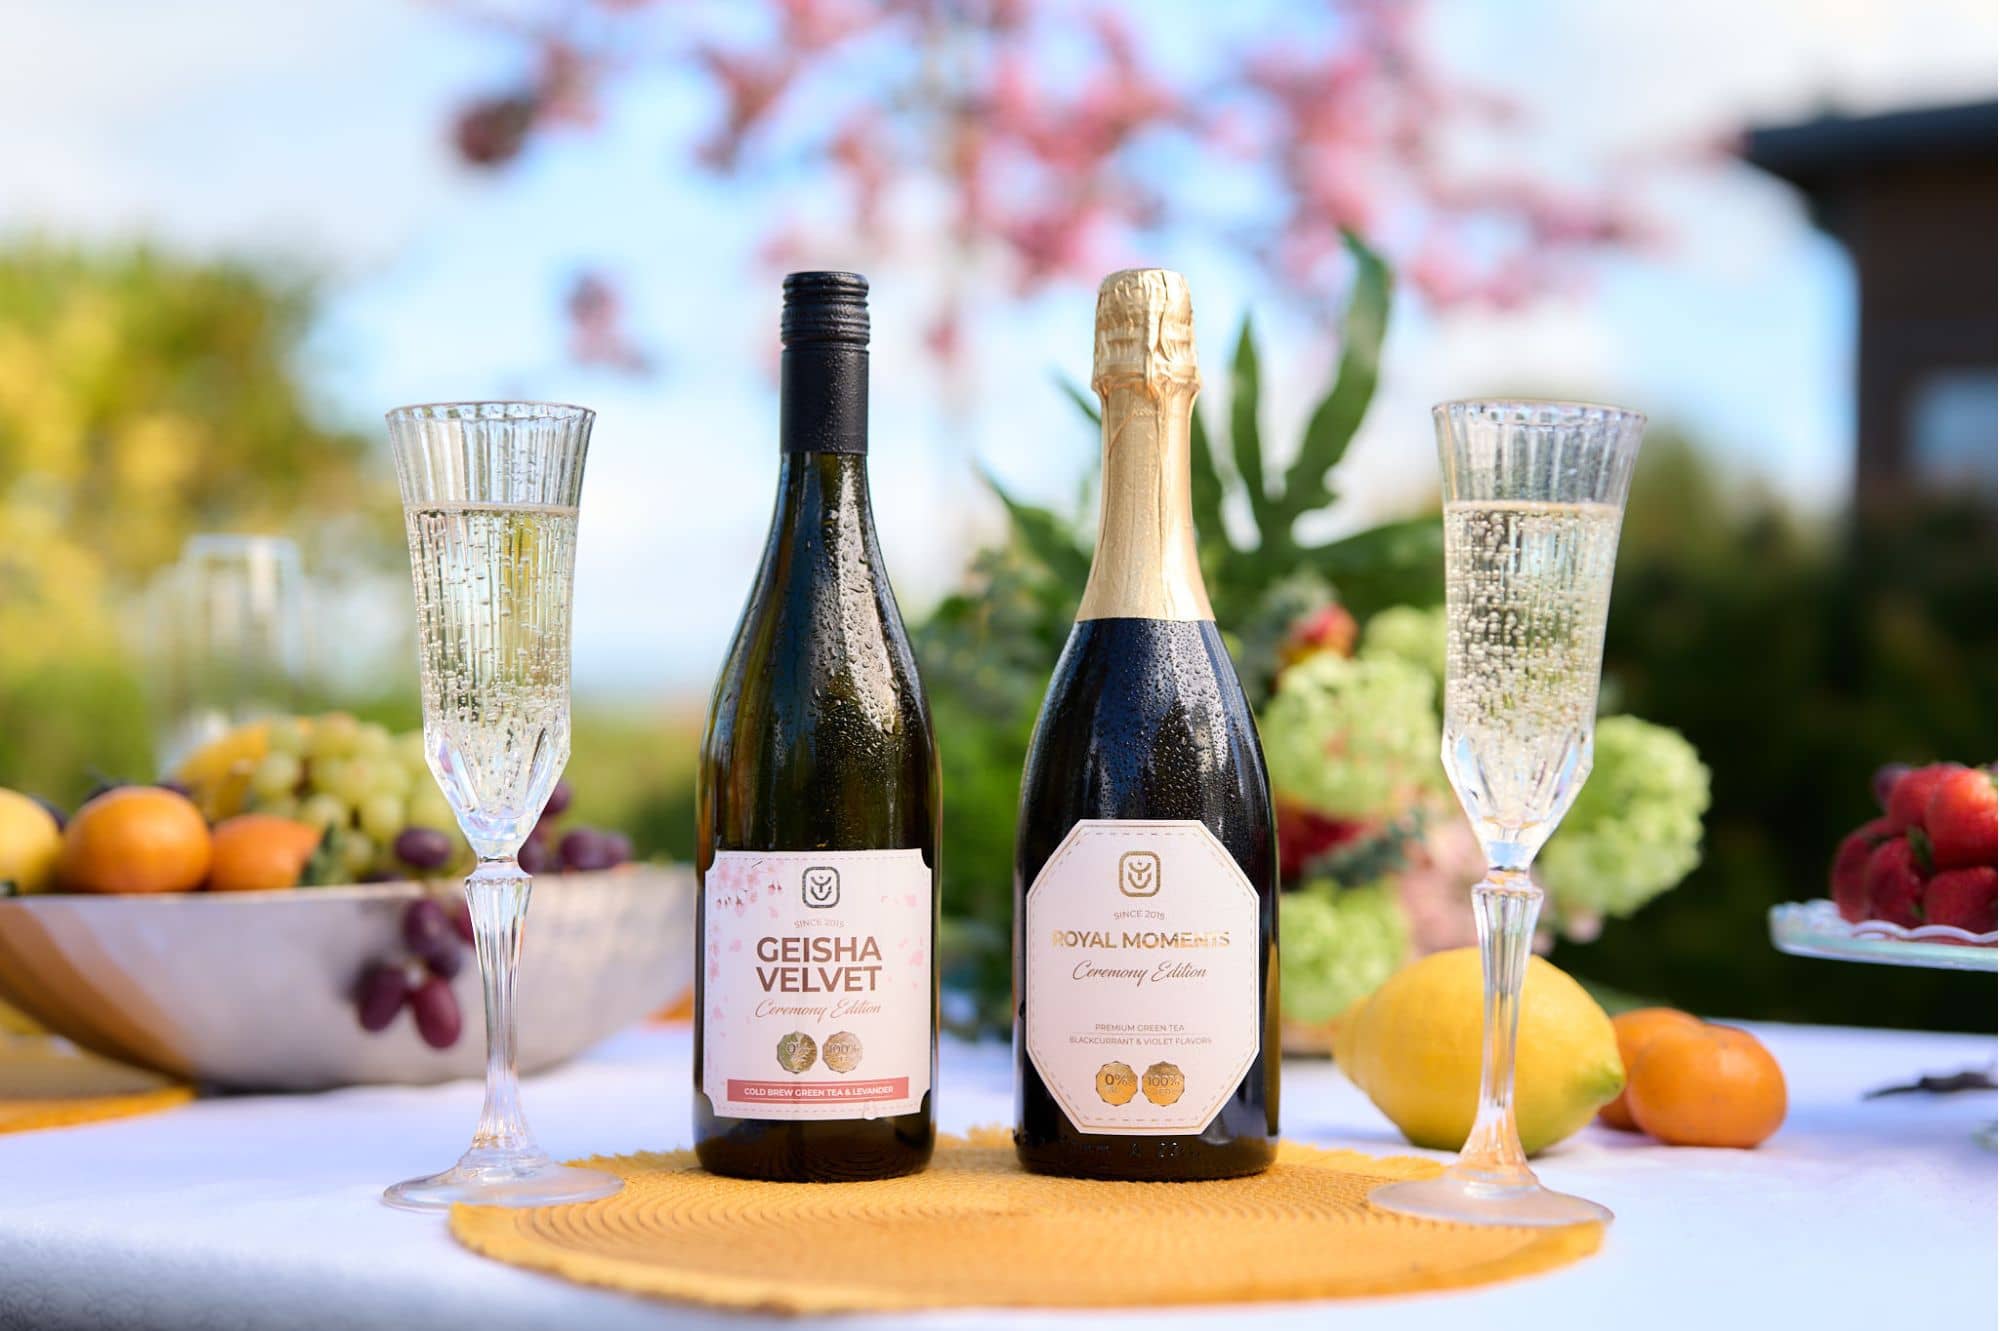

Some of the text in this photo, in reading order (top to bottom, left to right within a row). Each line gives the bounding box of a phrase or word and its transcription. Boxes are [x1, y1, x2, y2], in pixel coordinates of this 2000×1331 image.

[1113, 910, 1143, 921] SINCE
[793, 919, 821, 929] SINCE
[1053, 930, 1231, 950] ROYAL MOMENTS
[757, 936, 882, 963] GEISHA
[756, 966, 883, 993] VELVET
[1072, 959, 1208, 987] Ceremony Edition
[755, 998, 882, 1024] Ceremony Edition
[1095, 1023, 1185, 1032] PREMIUM GREEN TEA
[1144, 1037, 1173, 1046] VIOLET
[1105, 1073, 1128, 1087] 0%
[1148, 1074, 1180, 1087] 100%
[744, 1086, 894, 1098] COLD BREW GREEN TEA & LEVANDER
